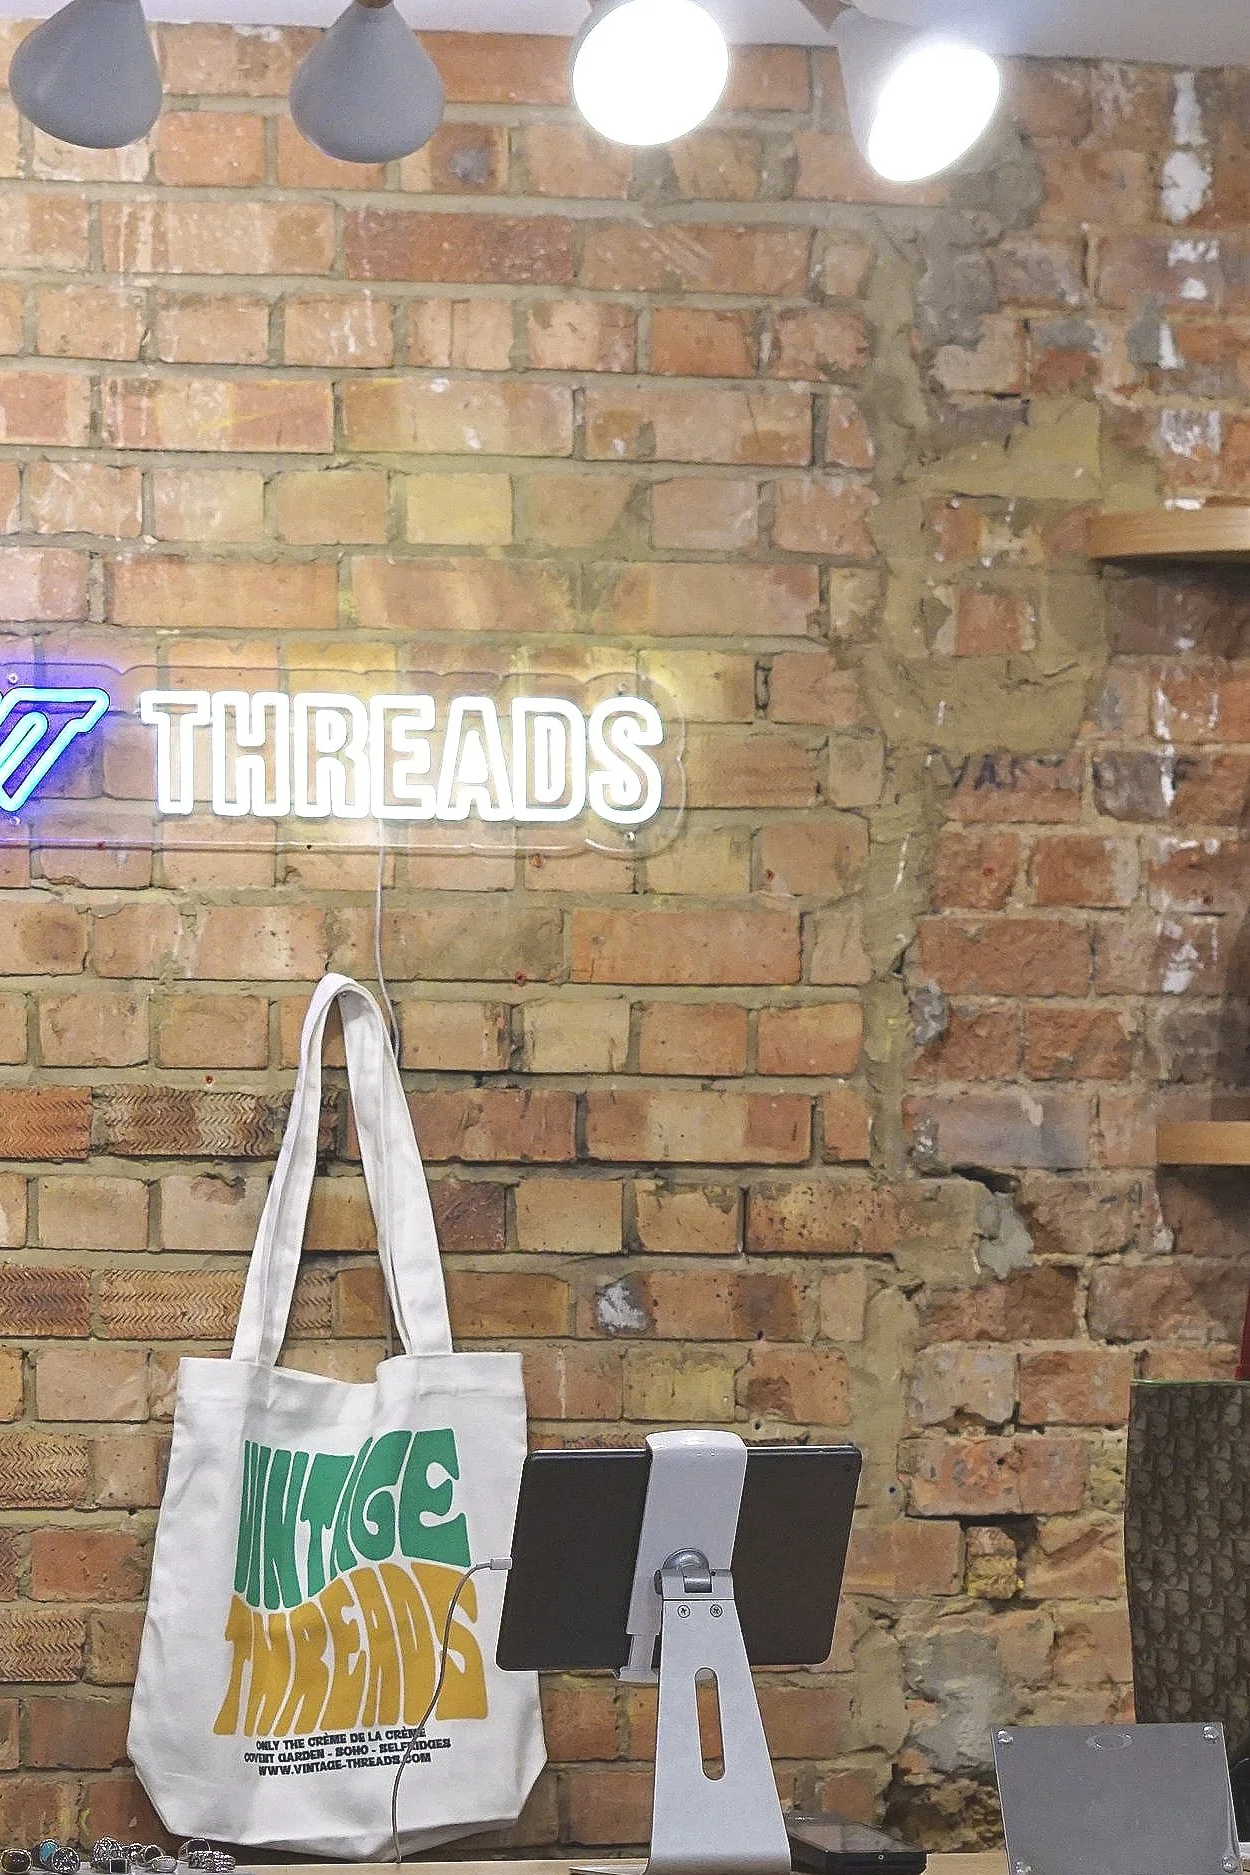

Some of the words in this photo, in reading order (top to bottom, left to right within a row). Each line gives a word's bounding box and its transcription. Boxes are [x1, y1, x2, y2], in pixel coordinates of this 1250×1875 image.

[141, 690, 664, 824] THREADS
[234, 1427, 472, 1610] VINTAGE
[213, 1562, 489, 1736] THREADS
[244, 1752, 275, 1764] COVENT
[277, 1748, 325, 1763] GARDEN
[335, 1744, 369, 1757] SOHO
[256, 1740, 280, 1751] ONLY
[283, 1738, 305, 1750] THE
[307, 1732, 347, 1747] CRÈME
[350, 1732, 365, 1743] DE
[368, 1731, 382, 1742] LA
[258, 1752, 432, 1776] WWW.VINTAGE-THREADSCOM
